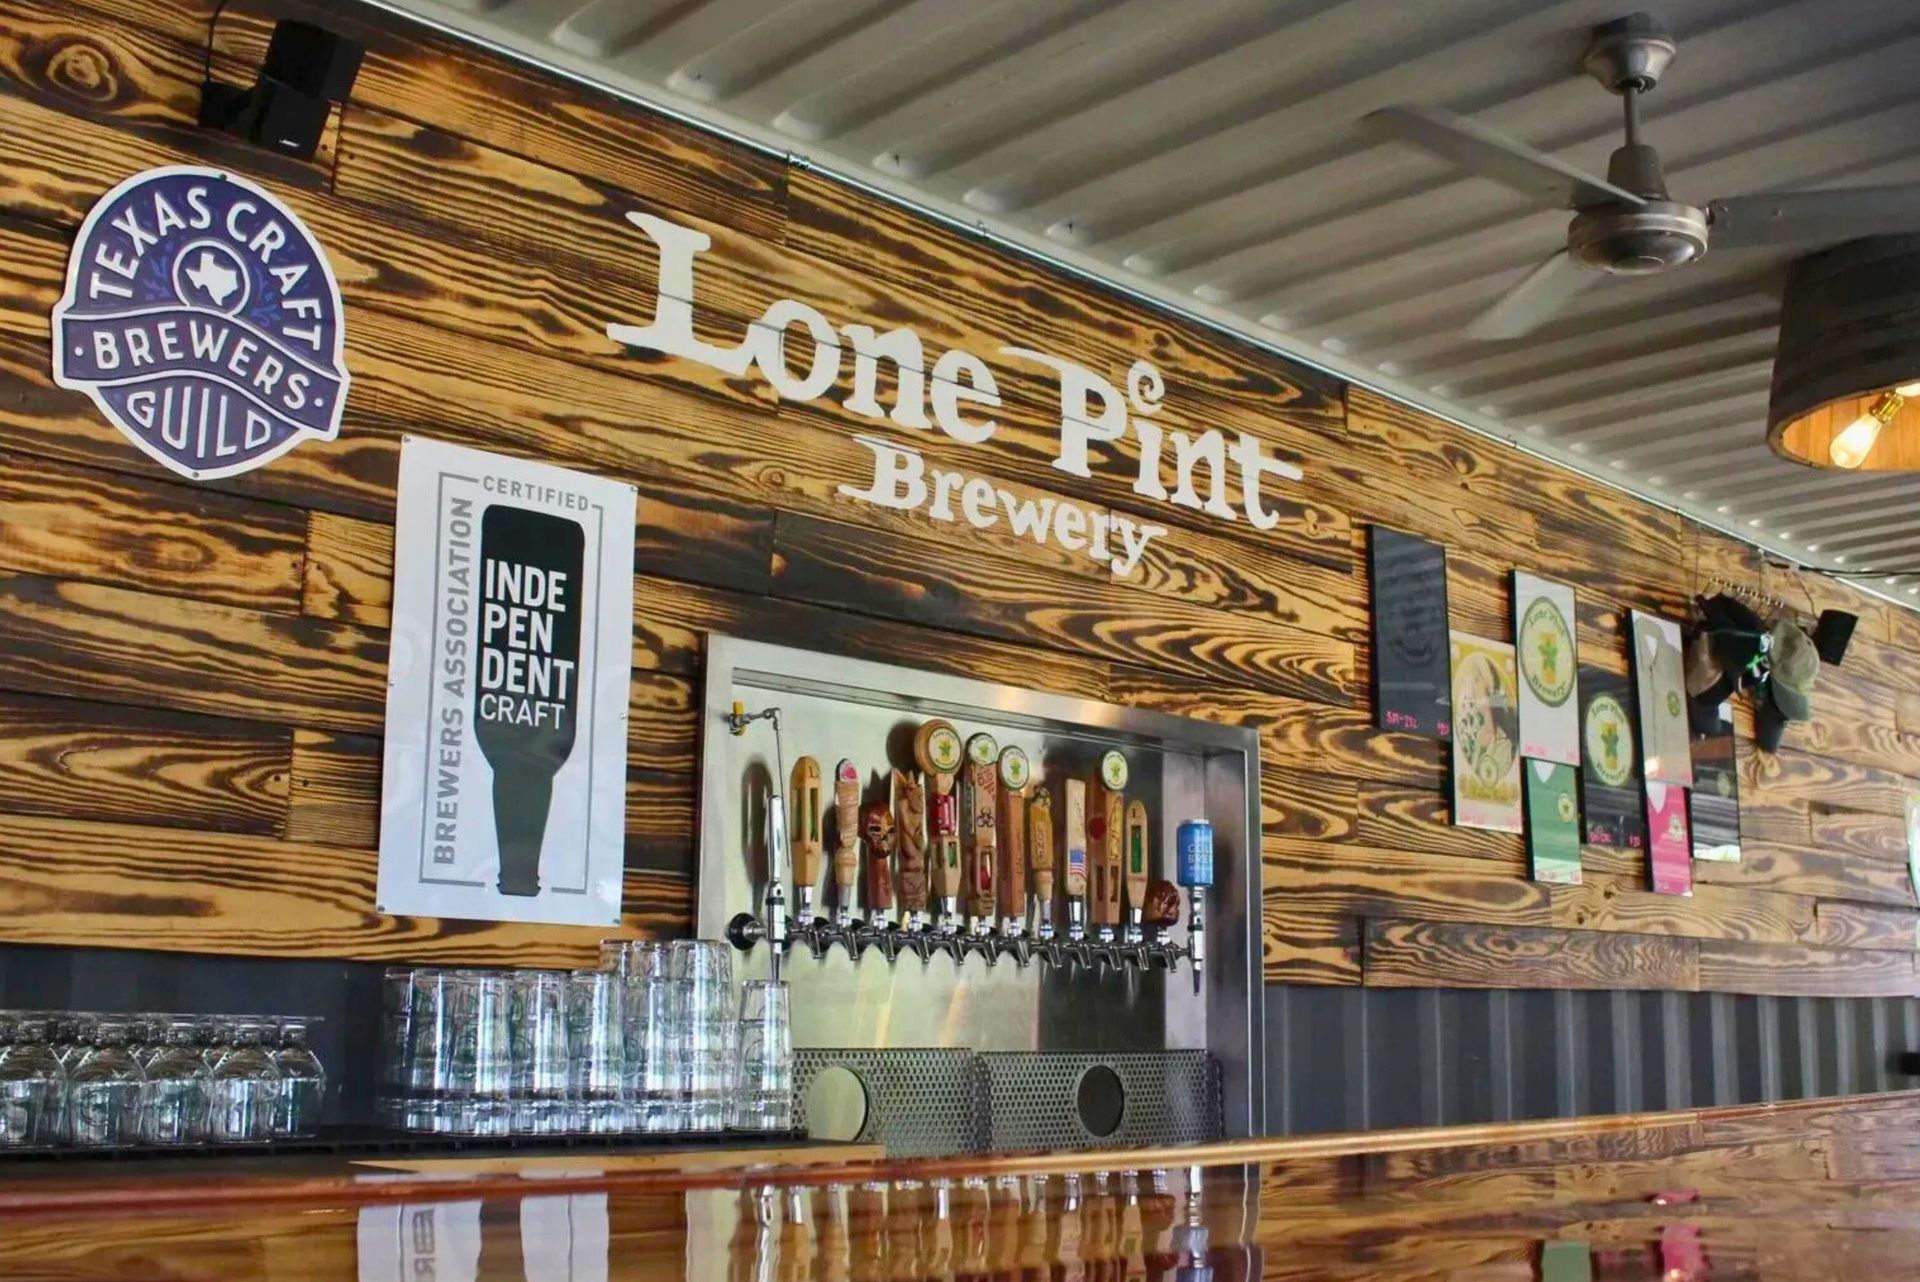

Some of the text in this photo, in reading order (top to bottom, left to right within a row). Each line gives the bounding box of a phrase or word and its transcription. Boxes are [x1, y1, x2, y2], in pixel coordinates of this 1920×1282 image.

[89, 187, 322, 351] TEXAS CRAFT
[93, 319, 311, 410] BREWERS
[605, 211, 1303, 530] Lone Pint
[126, 386, 271, 458] GUILD
[483, 475, 590, 512] CERTIFIED
[837, 434, 1168, 577] Brewery
[485, 559, 567, 612] INDE
[485, 608, 554, 653] PEN
[434, 497, 473, 865] BREWERS ASSOCIATION
[482, 650, 574, 699] DENT
[479, 692, 566, 730] CRAFT
